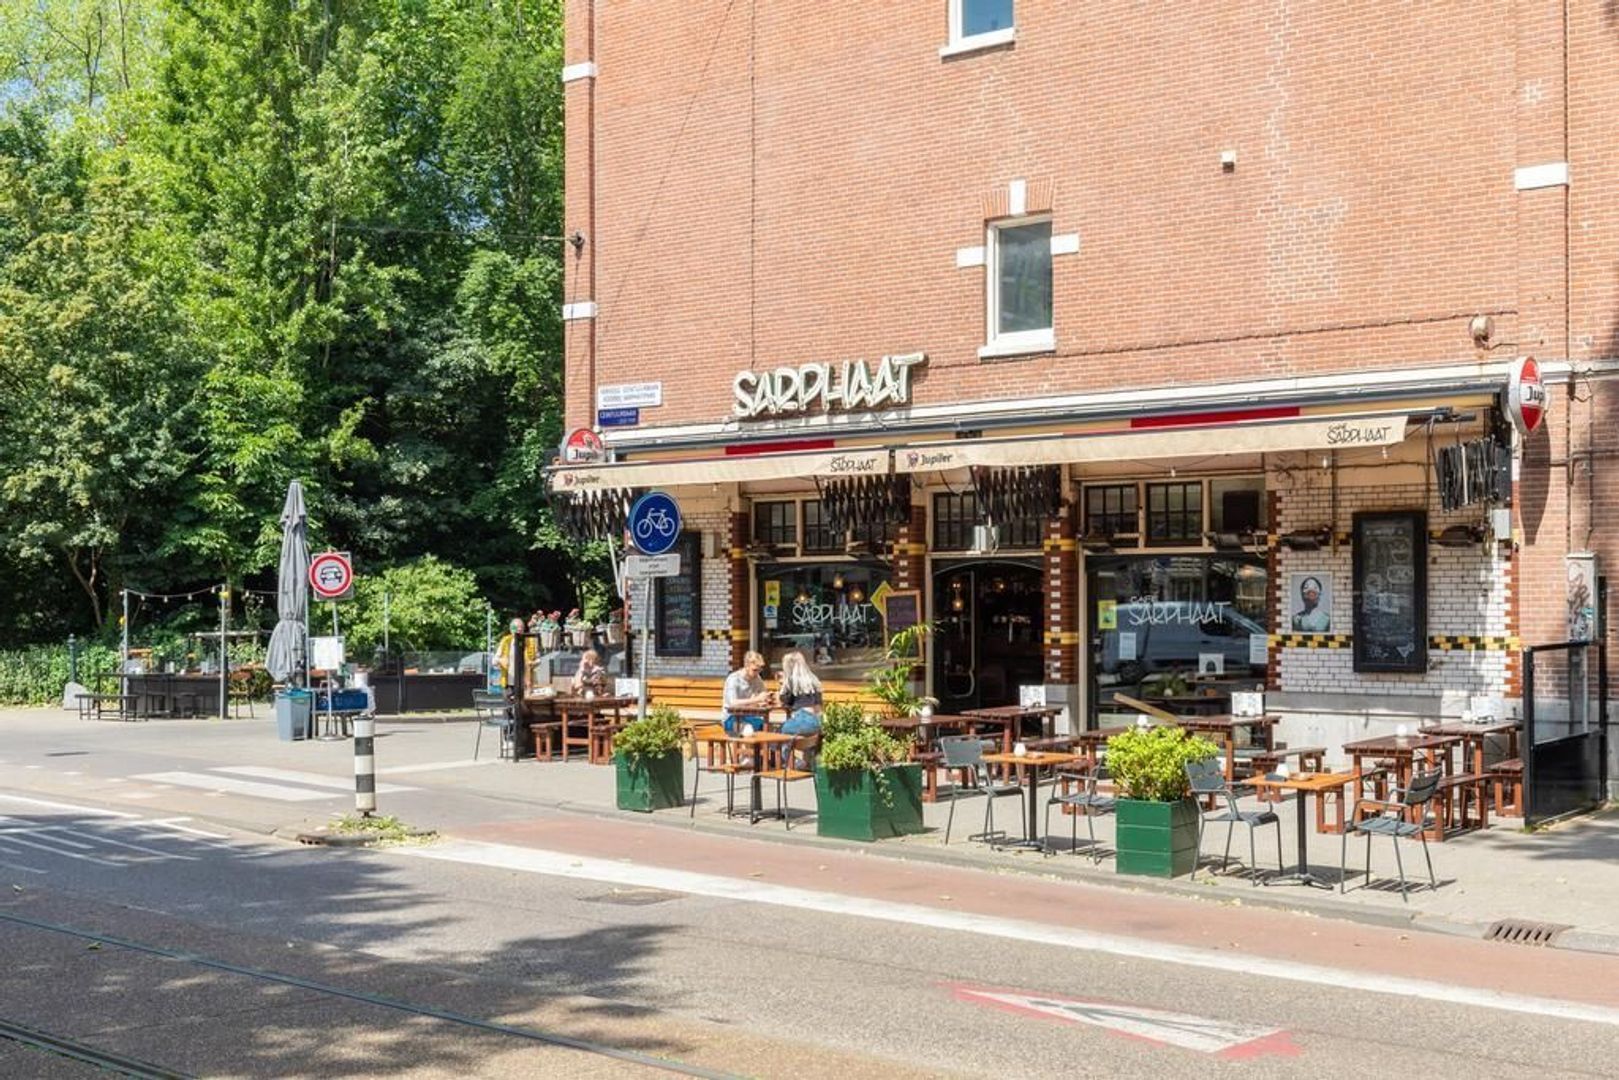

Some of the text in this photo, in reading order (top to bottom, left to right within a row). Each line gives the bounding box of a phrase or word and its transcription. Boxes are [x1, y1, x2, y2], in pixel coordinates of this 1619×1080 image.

[733, 352, 925, 417] SARPHAAT
[792, 604, 872, 625] SARPHAAT
[1128, 602, 1231, 626] SARPHAAT
